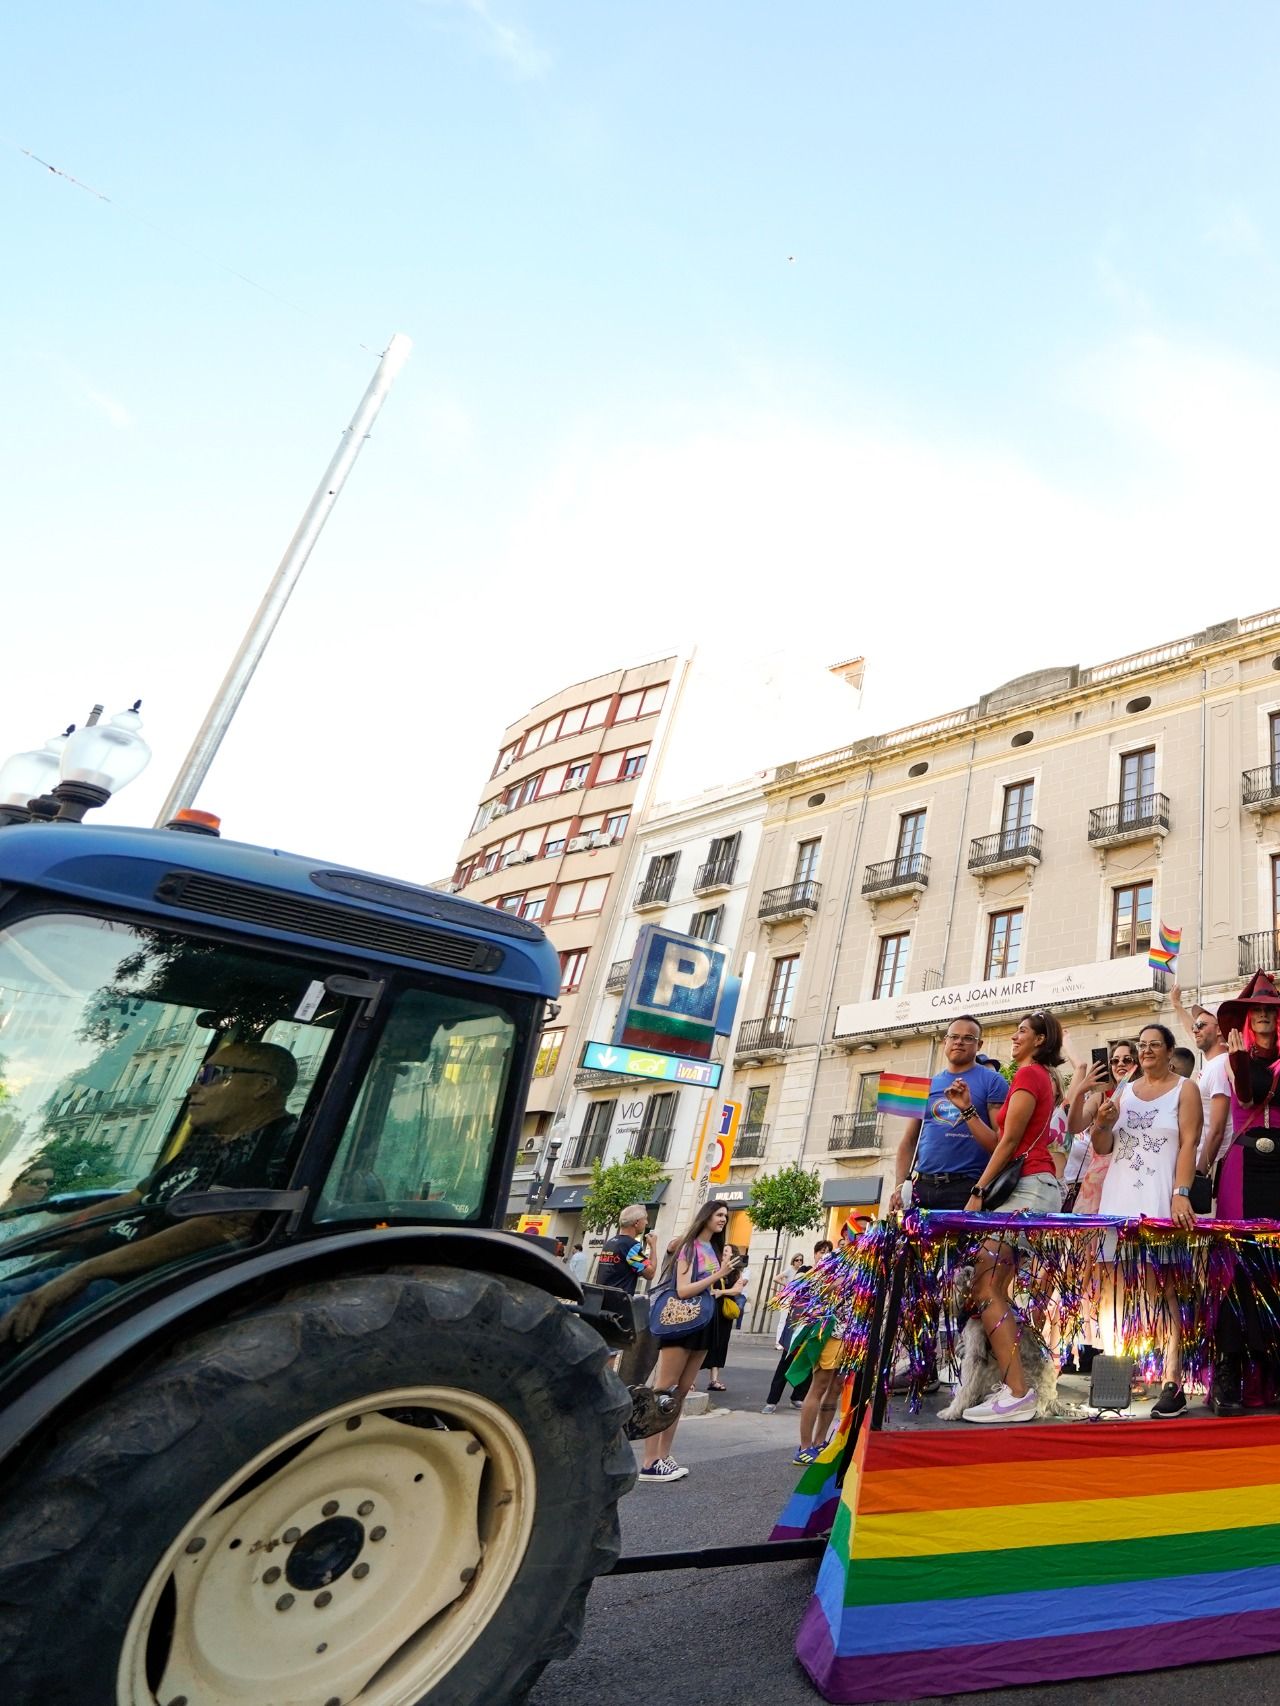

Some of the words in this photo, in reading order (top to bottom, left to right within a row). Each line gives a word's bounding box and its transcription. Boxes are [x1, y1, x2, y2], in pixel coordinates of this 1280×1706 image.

[653, 942, 710, 1007] P
[931, 993, 962, 1007] CASA
[966, 986, 998, 1003] JOAN
[1001, 980, 1036, 995] MIRET
[621, 1101, 644, 1121] VIO
[715, 1191, 744, 1201] MULAYA
